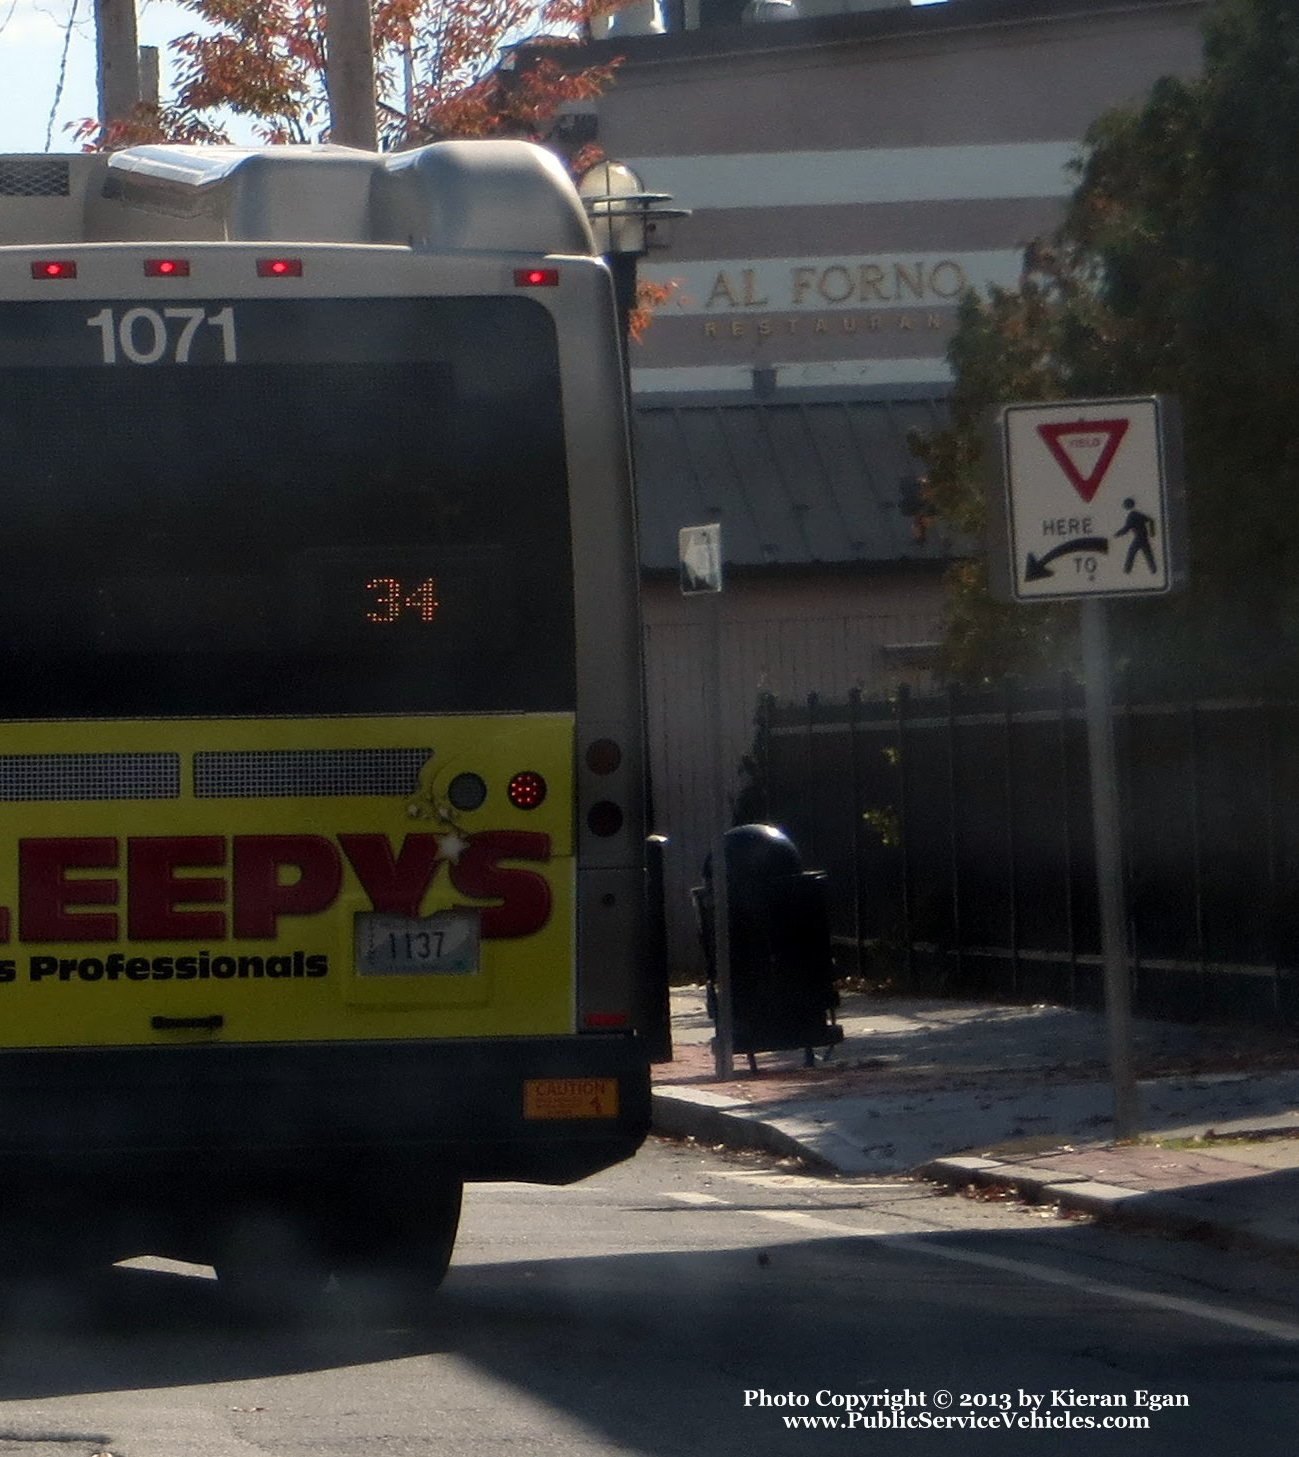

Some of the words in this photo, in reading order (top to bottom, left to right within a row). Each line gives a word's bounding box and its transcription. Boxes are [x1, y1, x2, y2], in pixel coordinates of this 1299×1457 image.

[704, 268, 768, 308] AL
[790, 259, 967, 304] FORNO
[86, 307, 238, 364] 1071
[704, 313, 942, 338] RESTAURAN
[1043, 517, 1093, 536] HERE
[1074, 557, 1098, 574] TO
[365, 578, 439, 622] 34
[389, 931, 445, 959] 1137
[29, 951, 329, 983] Professionals
[534, 1081, 606, 1096] CAUTION
